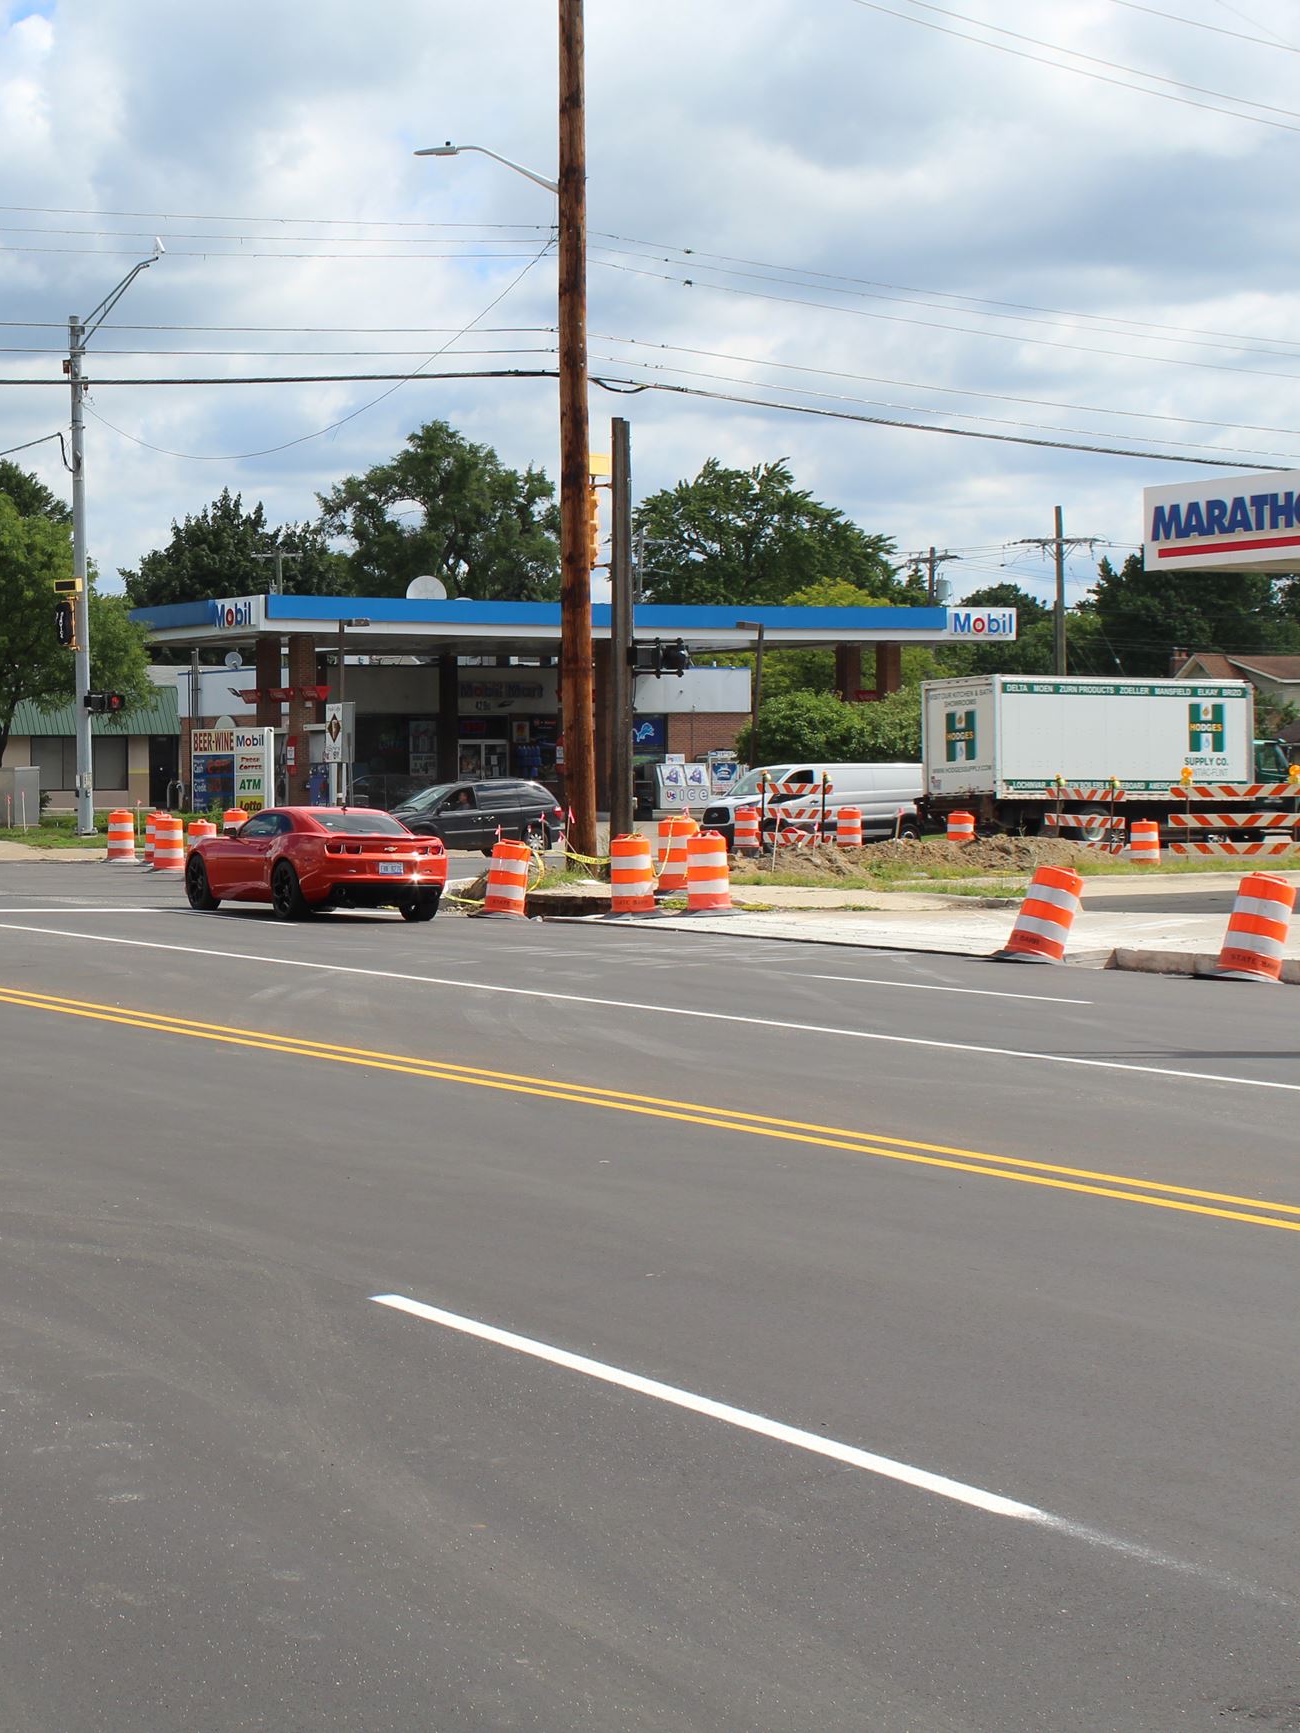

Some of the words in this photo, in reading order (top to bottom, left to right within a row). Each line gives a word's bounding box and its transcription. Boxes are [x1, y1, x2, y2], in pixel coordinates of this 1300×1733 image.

[214, 602, 252, 628] Mobil
[953, 613, 1013, 633] Mobil
[1006, 684, 1029, 692] DELTA
[1033, 684, 1053, 693] MOEN
[1059, 685, 1078, 693] ZURN
[1078, 686, 1115, 694] PRODUCTS
[1119, 687, 1150, 695] ZOELLER
[1154, 688, 1192, 696] MANSFIELD
[1221, 689, 1242, 697] BRIZO
[1189, 723, 1223, 732] HODGES
[236, 734, 264, 747] Mobil
[946, 731, 974, 741] HODGES
[1184, 757, 1214, 766] SUPPLY
[1215, 758, 1229, 766] CO.
[239, 779, 261, 790] ATM
[1012, 781, 1046, 789] LOCHINVAR
[240, 800, 262, 811] Lotto
